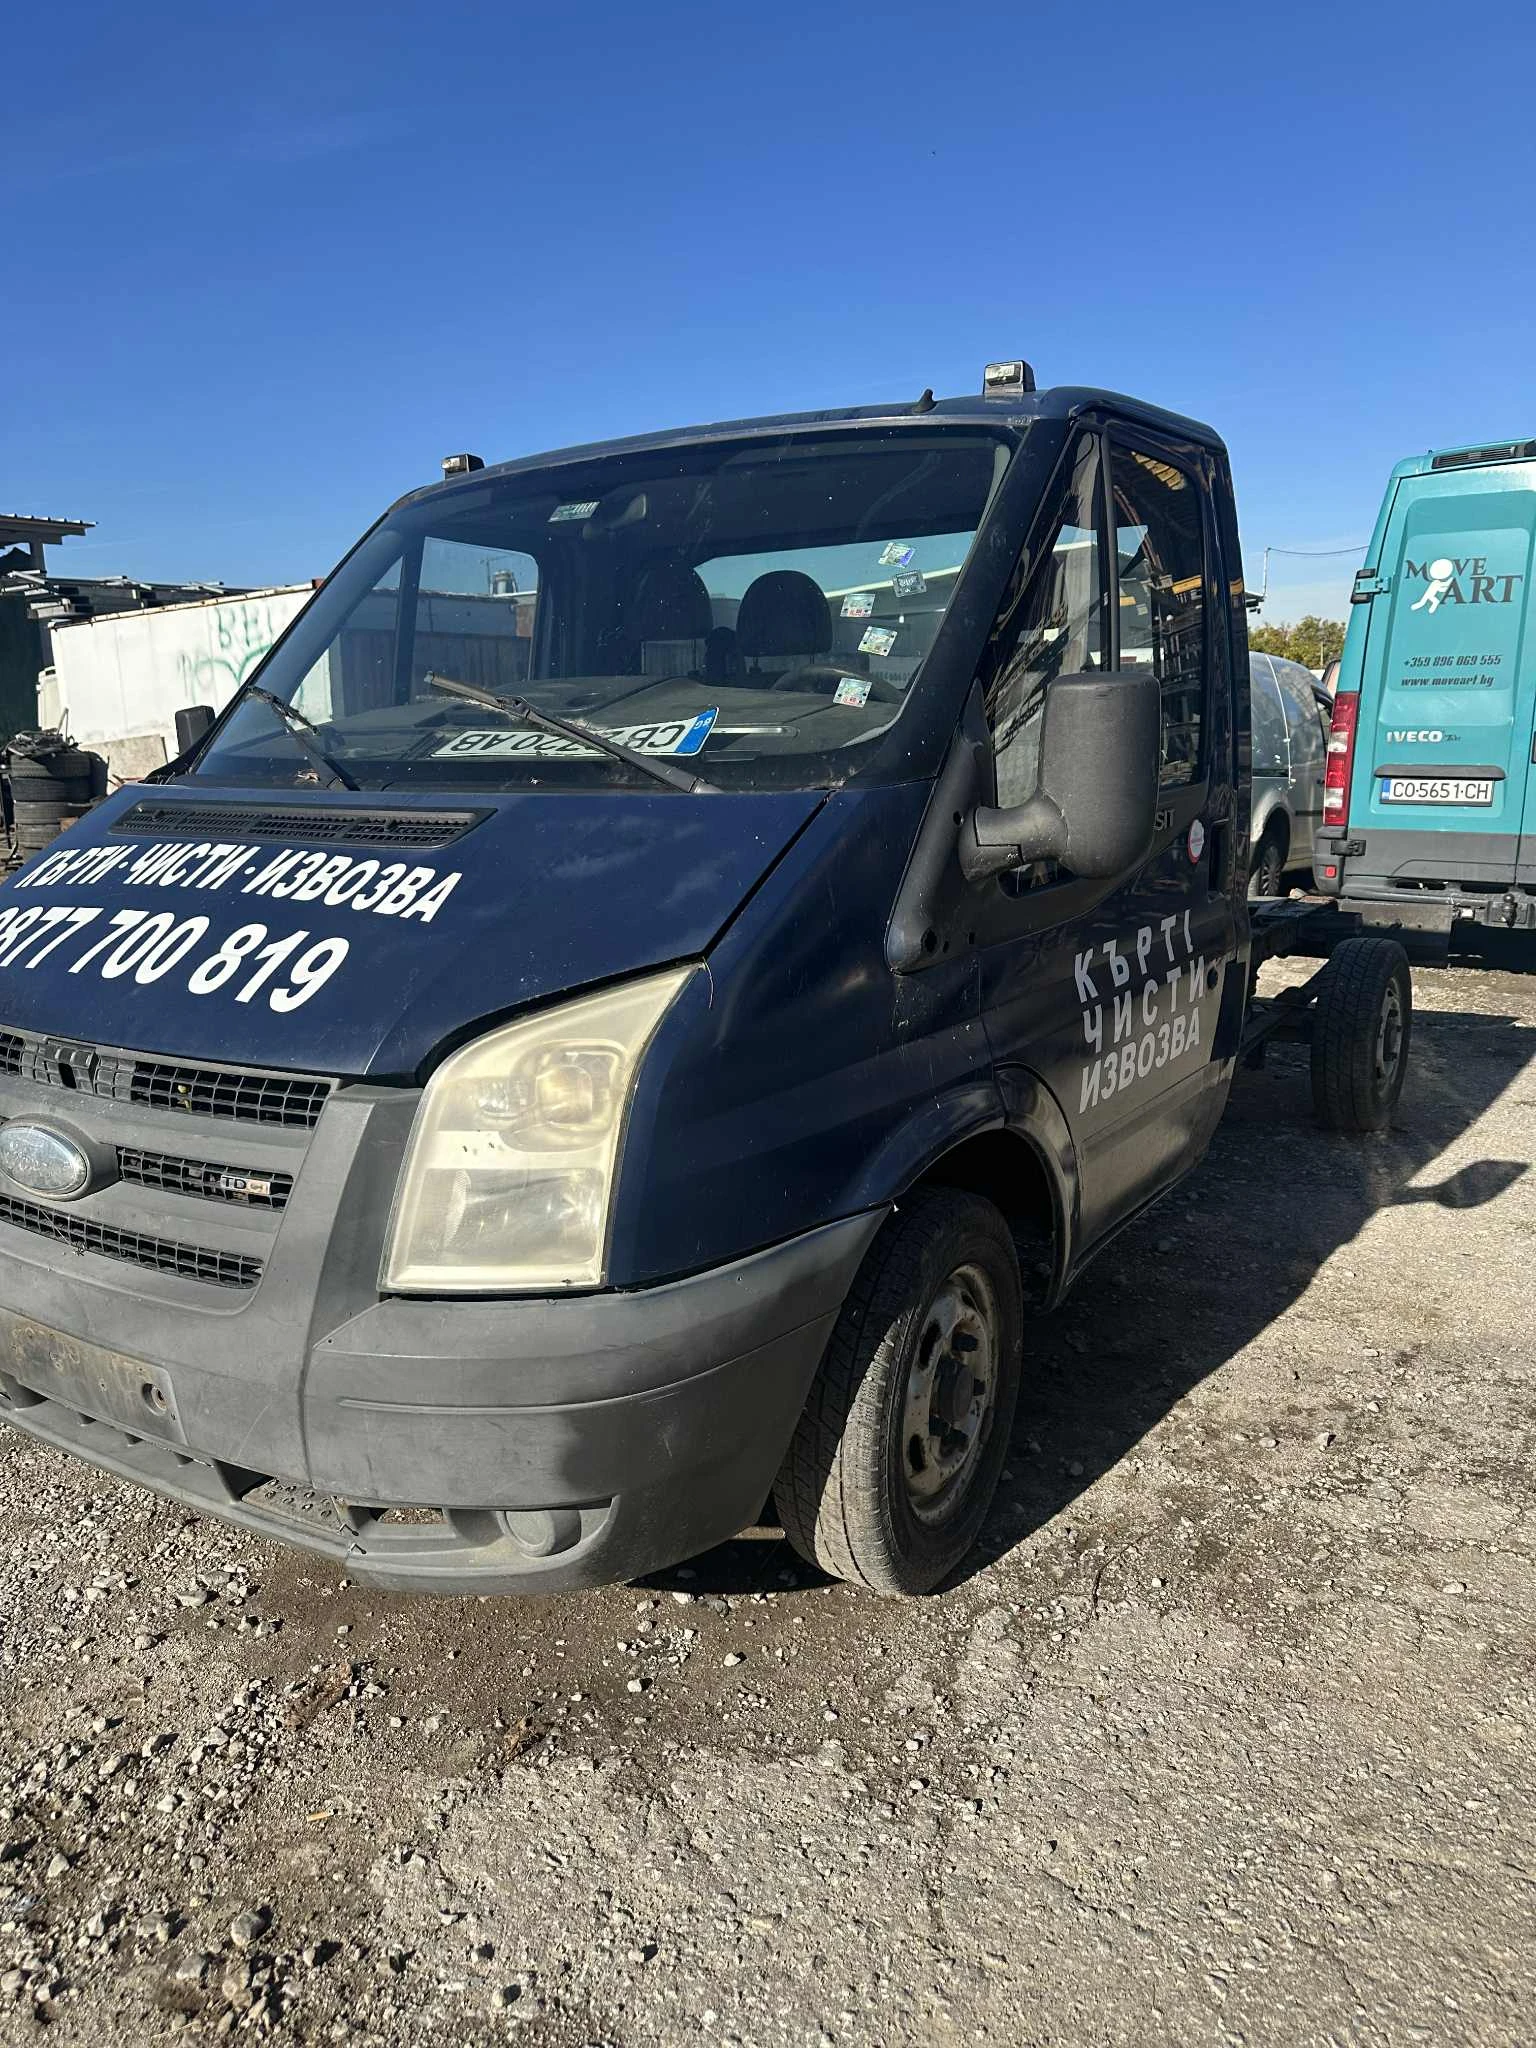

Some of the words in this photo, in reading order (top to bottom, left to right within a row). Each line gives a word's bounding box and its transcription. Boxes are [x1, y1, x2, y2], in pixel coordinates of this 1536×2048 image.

[1440, 574, 1524, 604] ART
[1404, 656, 1430, 667] +359
[1432, 655, 1455, 666] 896
[1479, 653, 1503, 665] 555
[1386, 731, 1443, 743] IVECO
[14, 845, 138, 888] КЪРТИ
[123, 843, 261, 889] ЧИСТИ
[240, 848, 463, 923] ИЗВОЗВА
[67, 910, 210, 984] 700
[188, 923, 349, 1013] 819
[1082, 955, 1204, 1053] ЧИСТИ
[1079, 1006, 1200, 1114] ИЗВОЗВА
